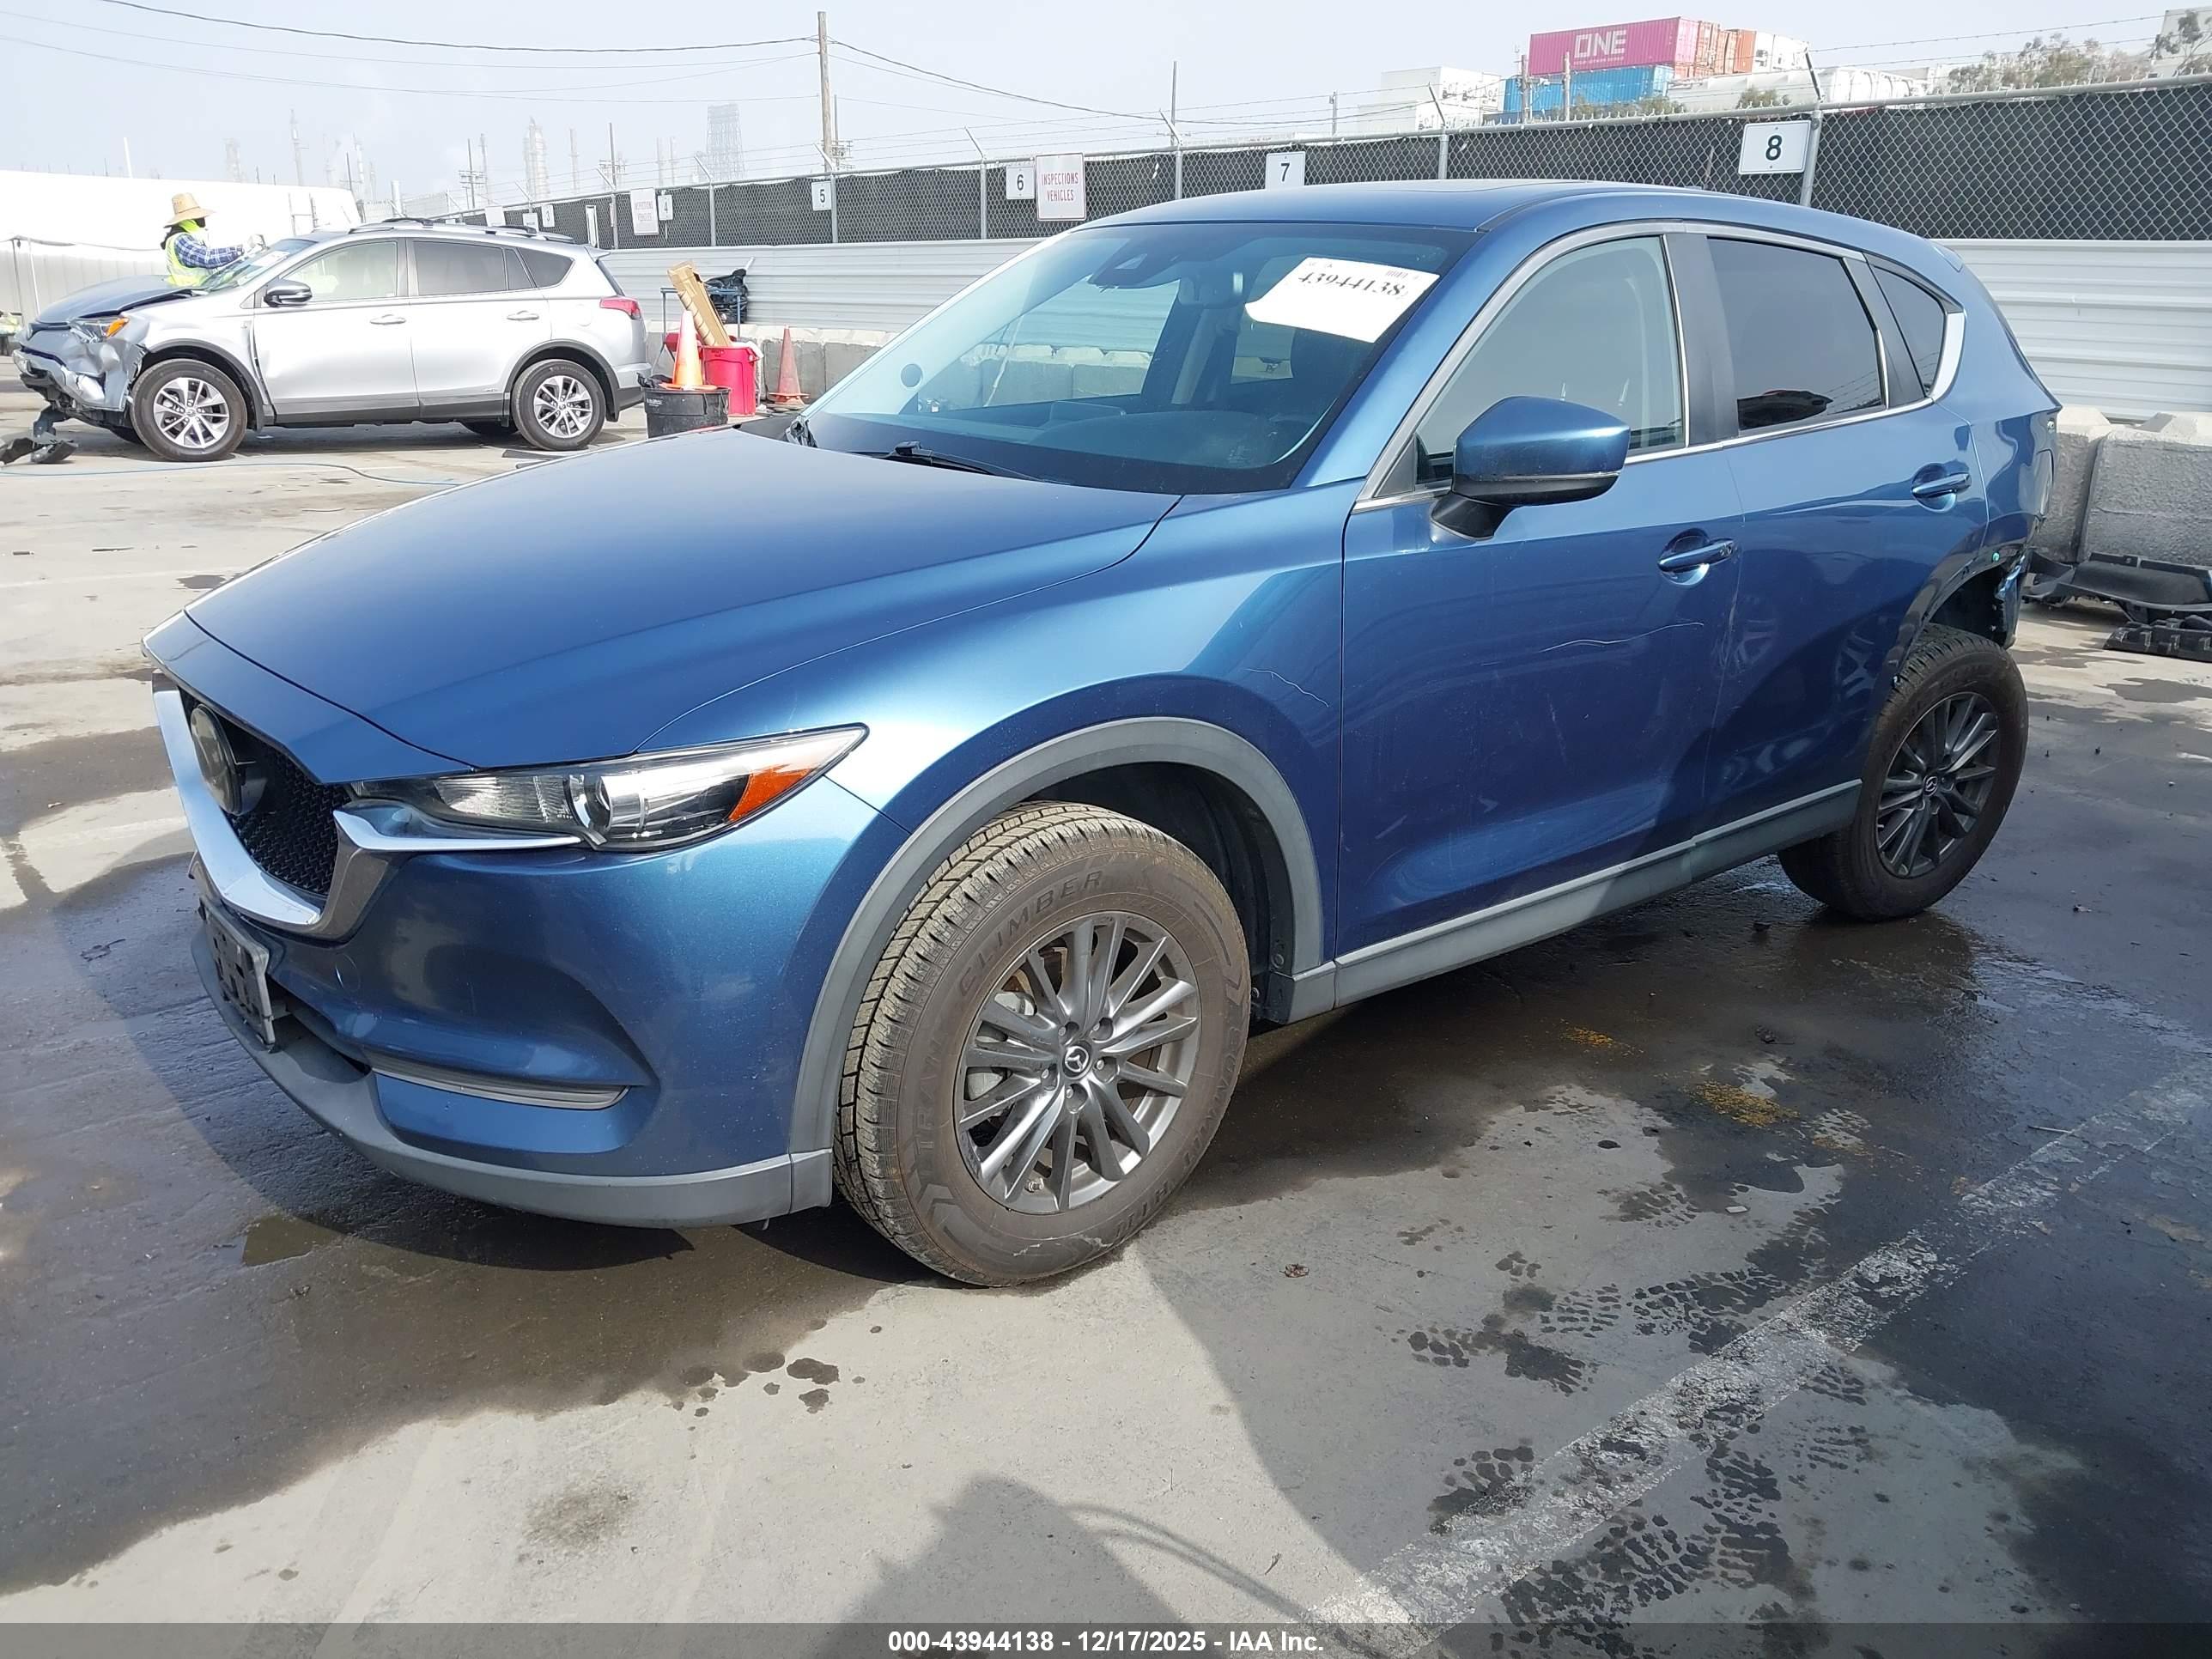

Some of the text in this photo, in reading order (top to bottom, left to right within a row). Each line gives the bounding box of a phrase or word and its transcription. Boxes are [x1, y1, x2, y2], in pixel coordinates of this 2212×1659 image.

[1574, 30, 1626, 58] ONE
[1765, 135, 1783, 161] 8
[1017, 173, 1024, 191] 6
[1041, 173, 1079, 185] INSPECTIONS
[1280, 162, 1291, 182] 7
[819, 188, 826, 204] 5
[1046, 189, 1074, 202] VEHICLES
[1298, 271, 1406, 296] 43944138
[958, 870, 1103, 997] CLIMBER
